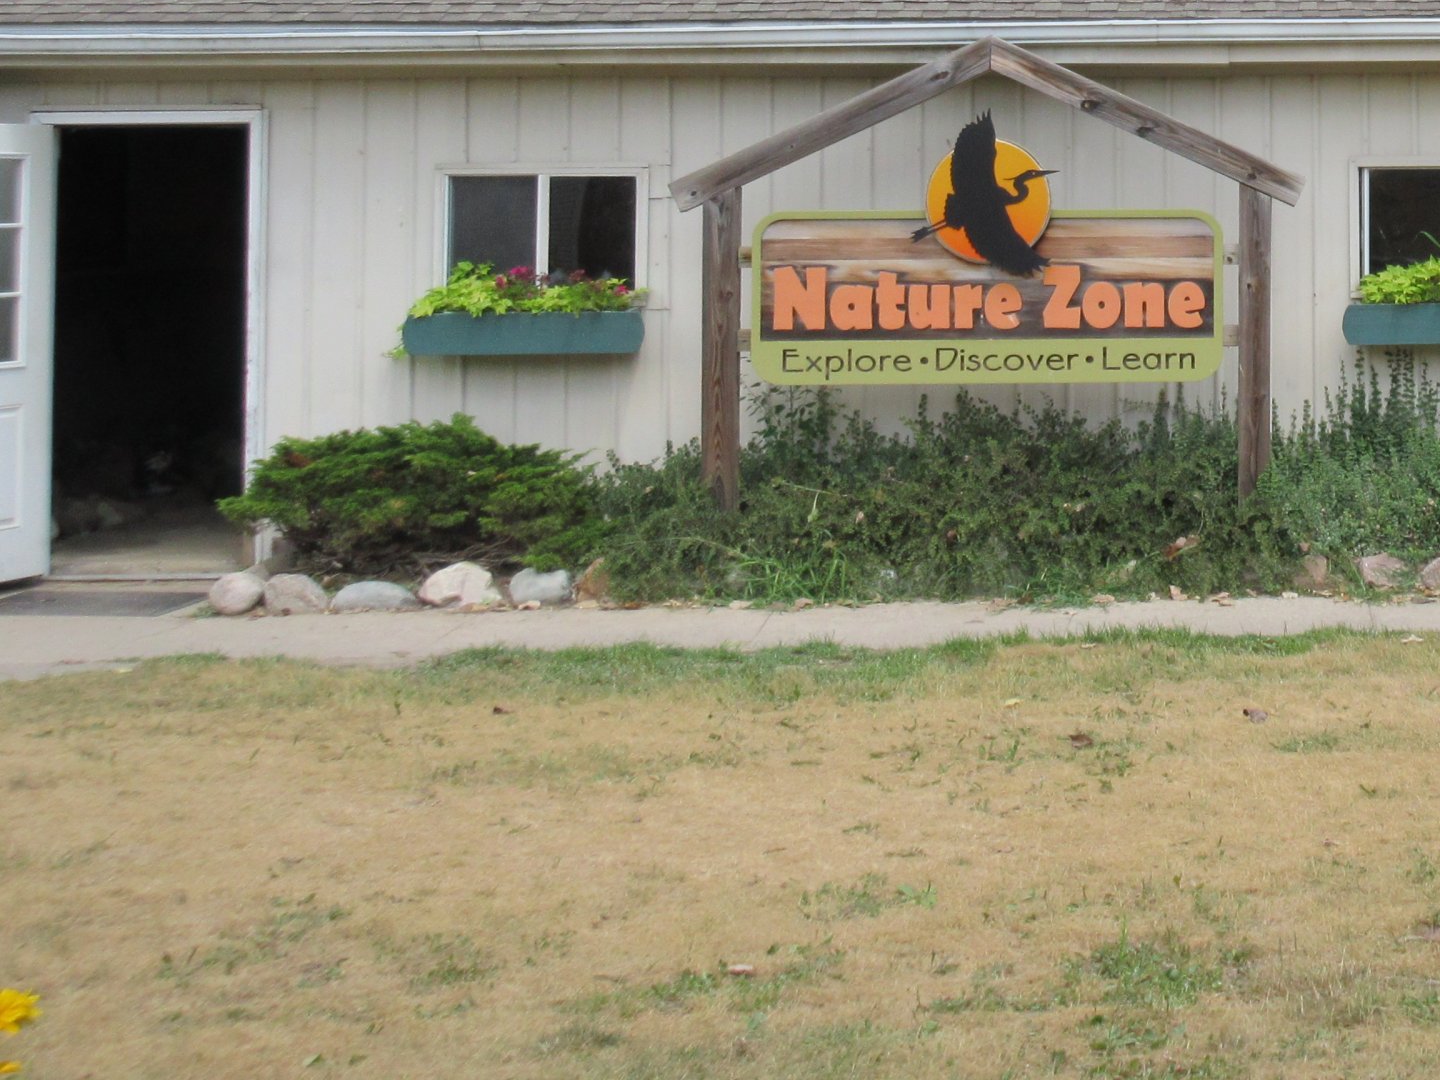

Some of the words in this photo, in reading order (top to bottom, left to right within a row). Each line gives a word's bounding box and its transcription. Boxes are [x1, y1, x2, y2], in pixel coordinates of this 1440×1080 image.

[772, 265, 1023, 331] Nature
[1042, 264, 1206, 330] Zone
[782, 348, 912, 380] Explore
[935, 347, 1079, 372] Discover
[1102, 346, 1196, 371] Learn
